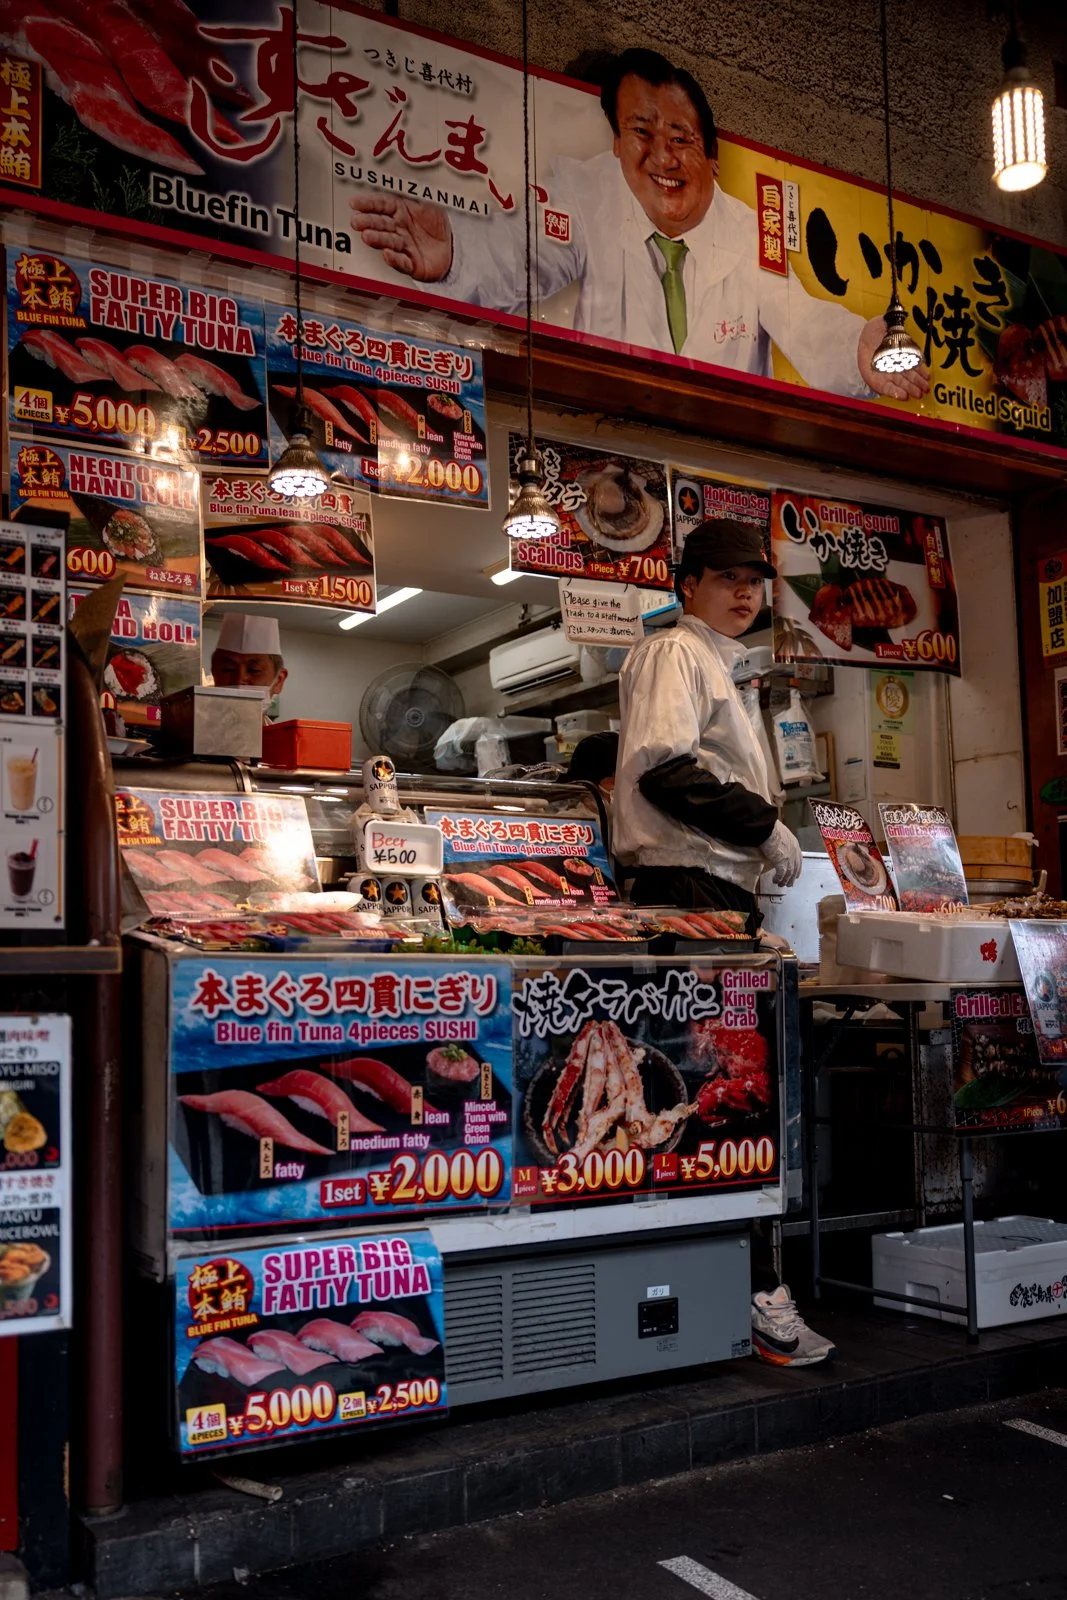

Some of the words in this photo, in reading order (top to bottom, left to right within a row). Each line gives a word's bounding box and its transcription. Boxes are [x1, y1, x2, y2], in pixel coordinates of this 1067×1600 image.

[365, 47, 474, 94] つきじ喜代村
[334, 162, 490, 216] SUSHIZANMAI
[152, 174, 270, 232] Bluefin
[278, 208, 352, 254] Tuna
[761, 183, 783, 264] 自家製
[17, 253, 71, 282] 極上
[22, 284, 74, 312] 本鮪
[89, 268, 183, 313] SUPER
[188, 289, 239, 326] BIG
[806, 207, 1008, 378] いか焼き
[17, 311, 41, 324] BLUE
[43, 314, 59, 326] FIN
[60, 315, 86, 328] TUNA
[90, 297, 178, 340] FATTY
[181, 315, 256, 357] TUNA
[277, 312, 474, 381] 本まぐろ四貫にぎり
[326, 350, 342, 368] fin
[344, 356, 373, 377] Tuna
[375, 365, 423, 386] 4pieces
[426, 376, 461, 394] SUSHI
[19, 391, 48, 409] 4個
[934, 383, 996, 417] Grilled
[998, 398, 1052, 432] Squid
[55, 394, 157, 433] ¥5,000
[188, 429, 260, 456] ¥2,500
[334, 439, 353, 452] fatty
[427, 432, 444, 443] lean
[453, 432, 475, 442] Minced
[454, 439, 469, 449] Tuna
[470, 441, 483, 450] with
[19, 448, 59, 468] 極上
[413, 442, 431, 455] fatty
[453, 445, 472, 455] Green
[453, 452, 472, 461] Onion
[22, 468, 61, 488] 本鮪
[19, 488, 36, 497] BLUE
[37, 489, 49, 498] FIN
[50, 490, 69, 499] TUNA
[69, 472, 136, 500] HAND
[141, 485, 195, 511] ROLL
[704, 485, 749, 507] Hokkido
[750, 495, 769, 511] Set
[210, 503, 233, 514] Blue
[235, 504, 250, 514] fin
[252, 505, 277, 516] Tuna
[278, 508, 301, 518] lean
[310, 511, 339, 525] pieces
[341, 517, 365, 531] SUSHI
[820, 504, 863, 529] Grilled
[866, 512, 900, 534] squid
[781, 501, 888, 571] いか焼き
[519, 542, 583, 569] Scallops
[148, 570, 193, 586] ねぎとろ巻
[619, 556, 668, 581] ¥700
[284, 581, 304, 593] 1set
[307, 575, 372, 605] ¥1,500
[562, 590, 590, 605] Please
[593, 599, 608, 608] give
[610, 599, 621, 608] the
[565, 608, 585, 618] trash
[1047, 585, 1065, 649] 加盟店
[143, 625, 196, 645] ROLL
[877, 645, 901, 658] 1piece
[904, 631, 956, 662] ¥600
[160, 798, 236, 821] SUPER
[162, 819, 235, 842] FATTY
[372, 832, 407, 848] Beer
[438, 817, 594, 845] 本まぐろ四貫にぎり
[821, 826, 843, 838] Grilled
[842, 830, 873, 842] Scallops
[888, 824, 914, 837] Grilled
[373, 850, 417, 866] ¥500
[453, 841, 477, 852] Blue
[478, 842, 492, 853] fin
[493, 843, 518, 854] Tuna
[520, 845, 556, 856] 4pieces
[559, 846, 588, 857] SUSHI
[570, 888, 584, 896] lean
[723, 971, 769, 989] Grilled
[193, 972, 496, 1016] 本まぐろ四貫にぎり
[723, 991, 756, 1009] King
[956, 994, 1009, 1016] Grilled
[724, 1010, 757, 1028] Crab
[216, 1022, 261, 1043] Blue
[267, 1022, 292, 1041] fin
[298, 1021, 343, 1042] Tuna
[349, 1021, 419, 1044] 4pieces
[425, 1020, 477, 1041] SUSHI
[412, 1088, 422, 1122] 赤身
[464, 1101, 497, 1113] Minced
[425, 1110, 450, 1124] lean
[464, 1112, 487, 1123] Tuna
[488, 1112, 507, 1123] with
[339, 1114, 348, 1148] 中とろ
[464, 1123, 490, 1134] Green
[464, 1133, 490, 1145] Onion
[351, 1134, 399, 1151] medium
[402, 1133, 431, 1150] fatty
[262, 1140, 271, 1176] 大とろ
[661, 1155, 670, 1168] L
[681, 1137, 774, 1180] ¥5,000
[275, 1162, 305, 1179] fatty
[370, 1150, 501, 1201] ¥2,000
[518, 1171, 531, 1182] M
[541, 1149, 645, 1193] ¥3,000
[656, 1168, 676, 1179] 1piece
[324, 1182, 362, 1204] 1set
[514, 1184, 536, 1194] 1piece
[263, 1243, 355, 1285] SUPER
[361, 1238, 412, 1270] BIG
[190, 1260, 245, 1292] 極上
[262, 1275, 350, 1316] FATTY
[357, 1264, 431, 1301] TUNA
[194, 1287, 248, 1321] 本鮪
[187, 1322, 214, 1338] BLUE
[214, 1319, 231, 1333] FIN
[231, 1313, 258, 1329] TUNA
[342, 1396, 363, 1410] 2個
[366, 1378, 440, 1414] ¥2,500
[228, 1382, 334, 1435] ¥5,000
[192, 1411, 222, 1430] 4個
